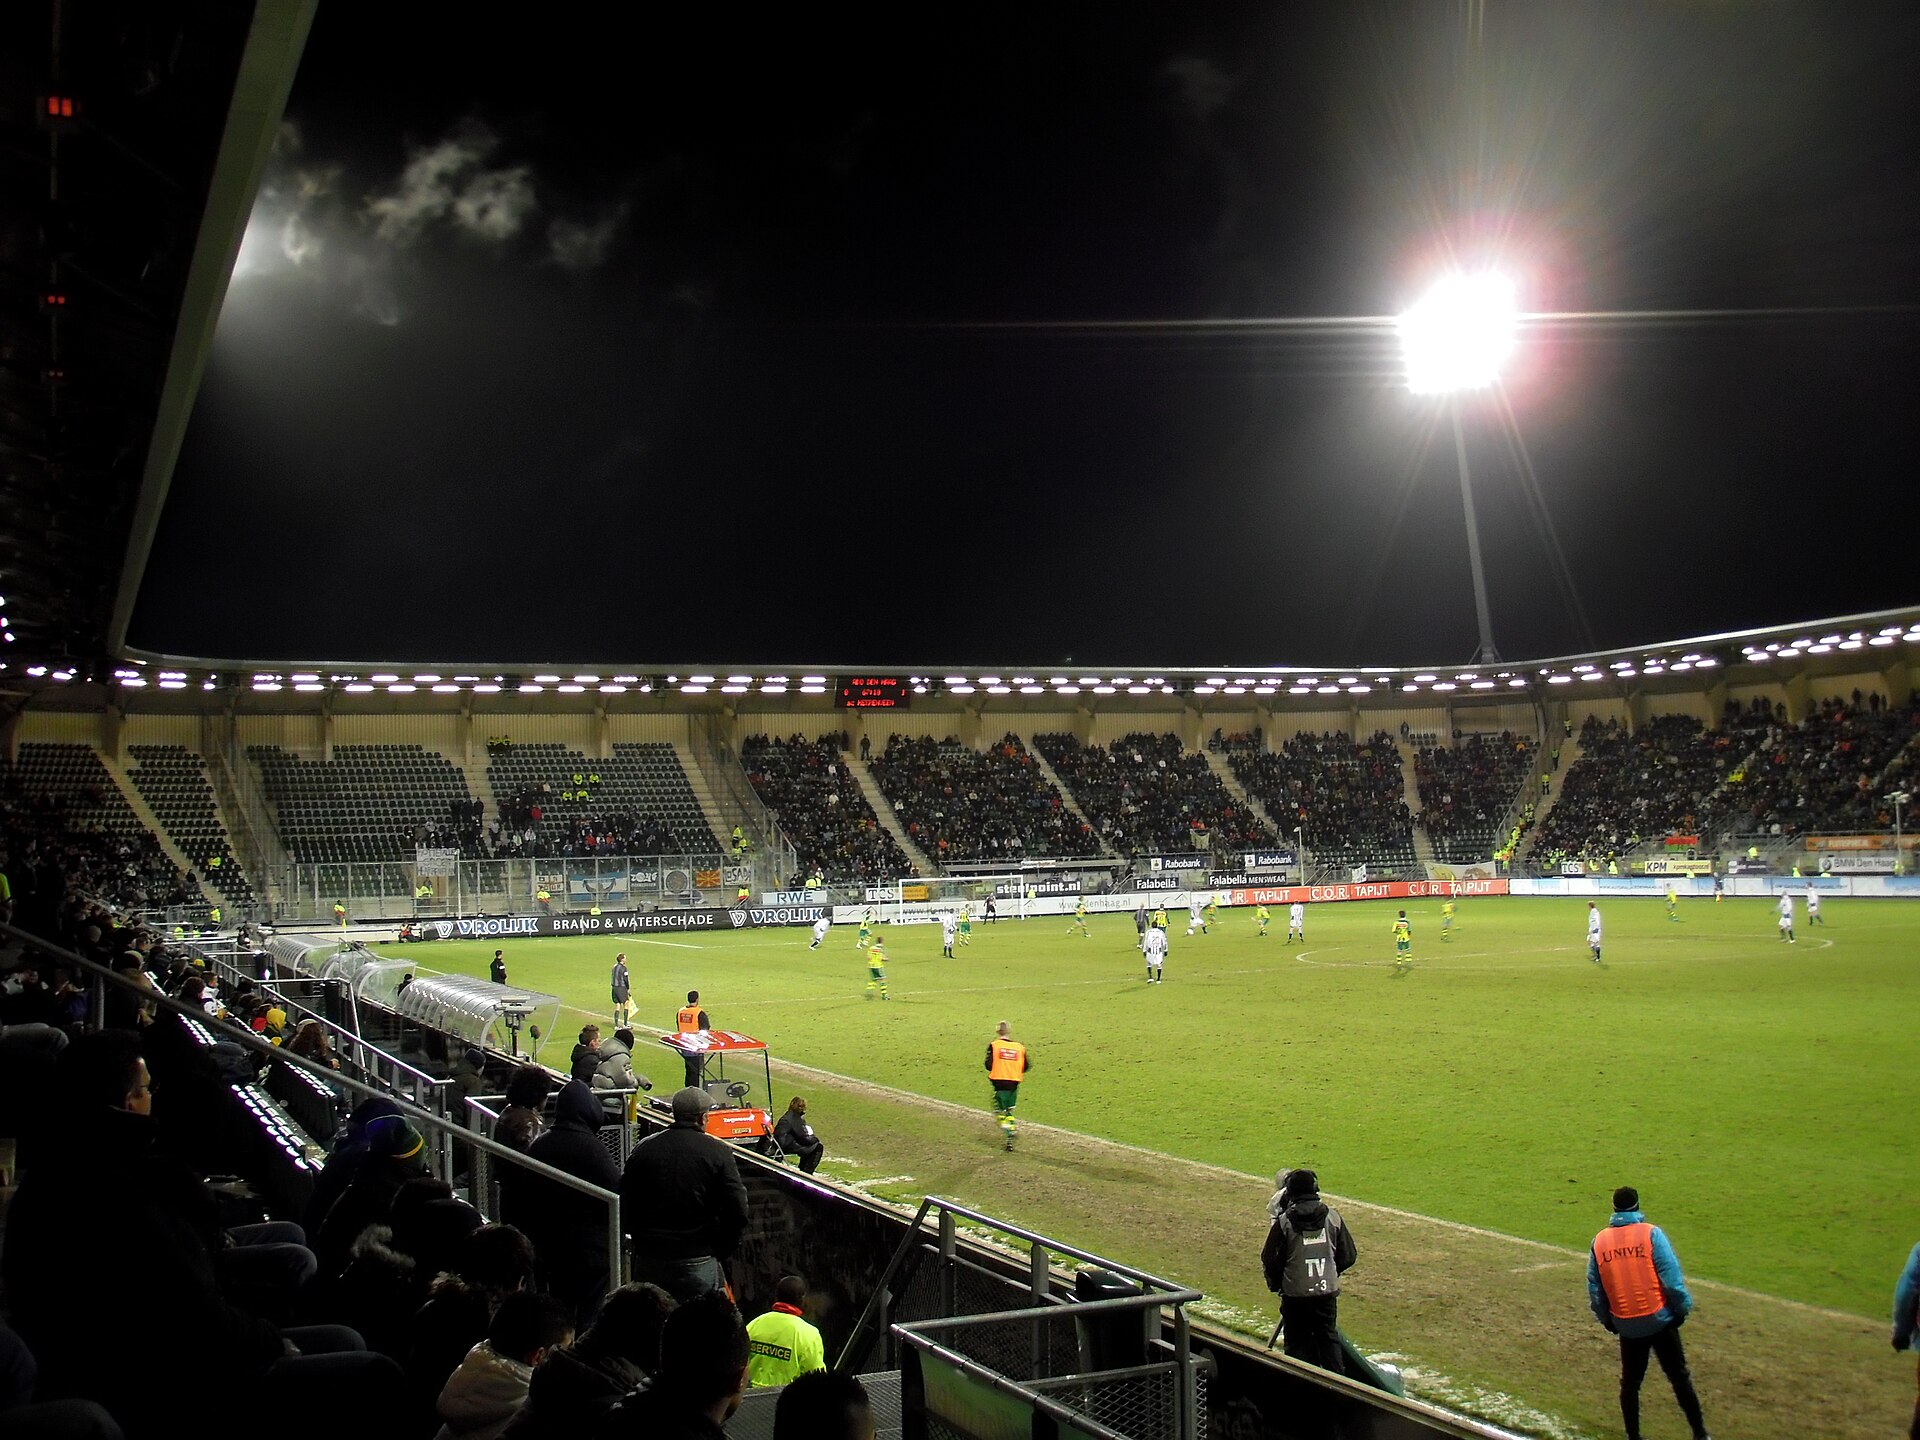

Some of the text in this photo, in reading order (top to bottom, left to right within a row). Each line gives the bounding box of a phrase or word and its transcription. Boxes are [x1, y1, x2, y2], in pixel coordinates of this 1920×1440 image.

[1164, 858, 1201, 869] Rabobank
[1258, 855, 1292, 865] Rabobank
[1562, 862, 1579, 873] TCS
[1646, 862, 1667, 872] KPM
[1248, 875, 1286, 884] MENSWEAR
[868, 888, 895, 899] TCS
[1253, 889, 1290, 902] TAPIJT
[1354, 885, 1388, 896] TAPIJT
[777, 892, 813, 903] RWE
[750, 907, 824, 924] VROLIJK
[456, 914, 714, 934] VROLIJK BRAND & WATERSCHADE
[1305, 1257, 1326, 1277] TV
[750, 1342, 791, 1360] SERVICE
